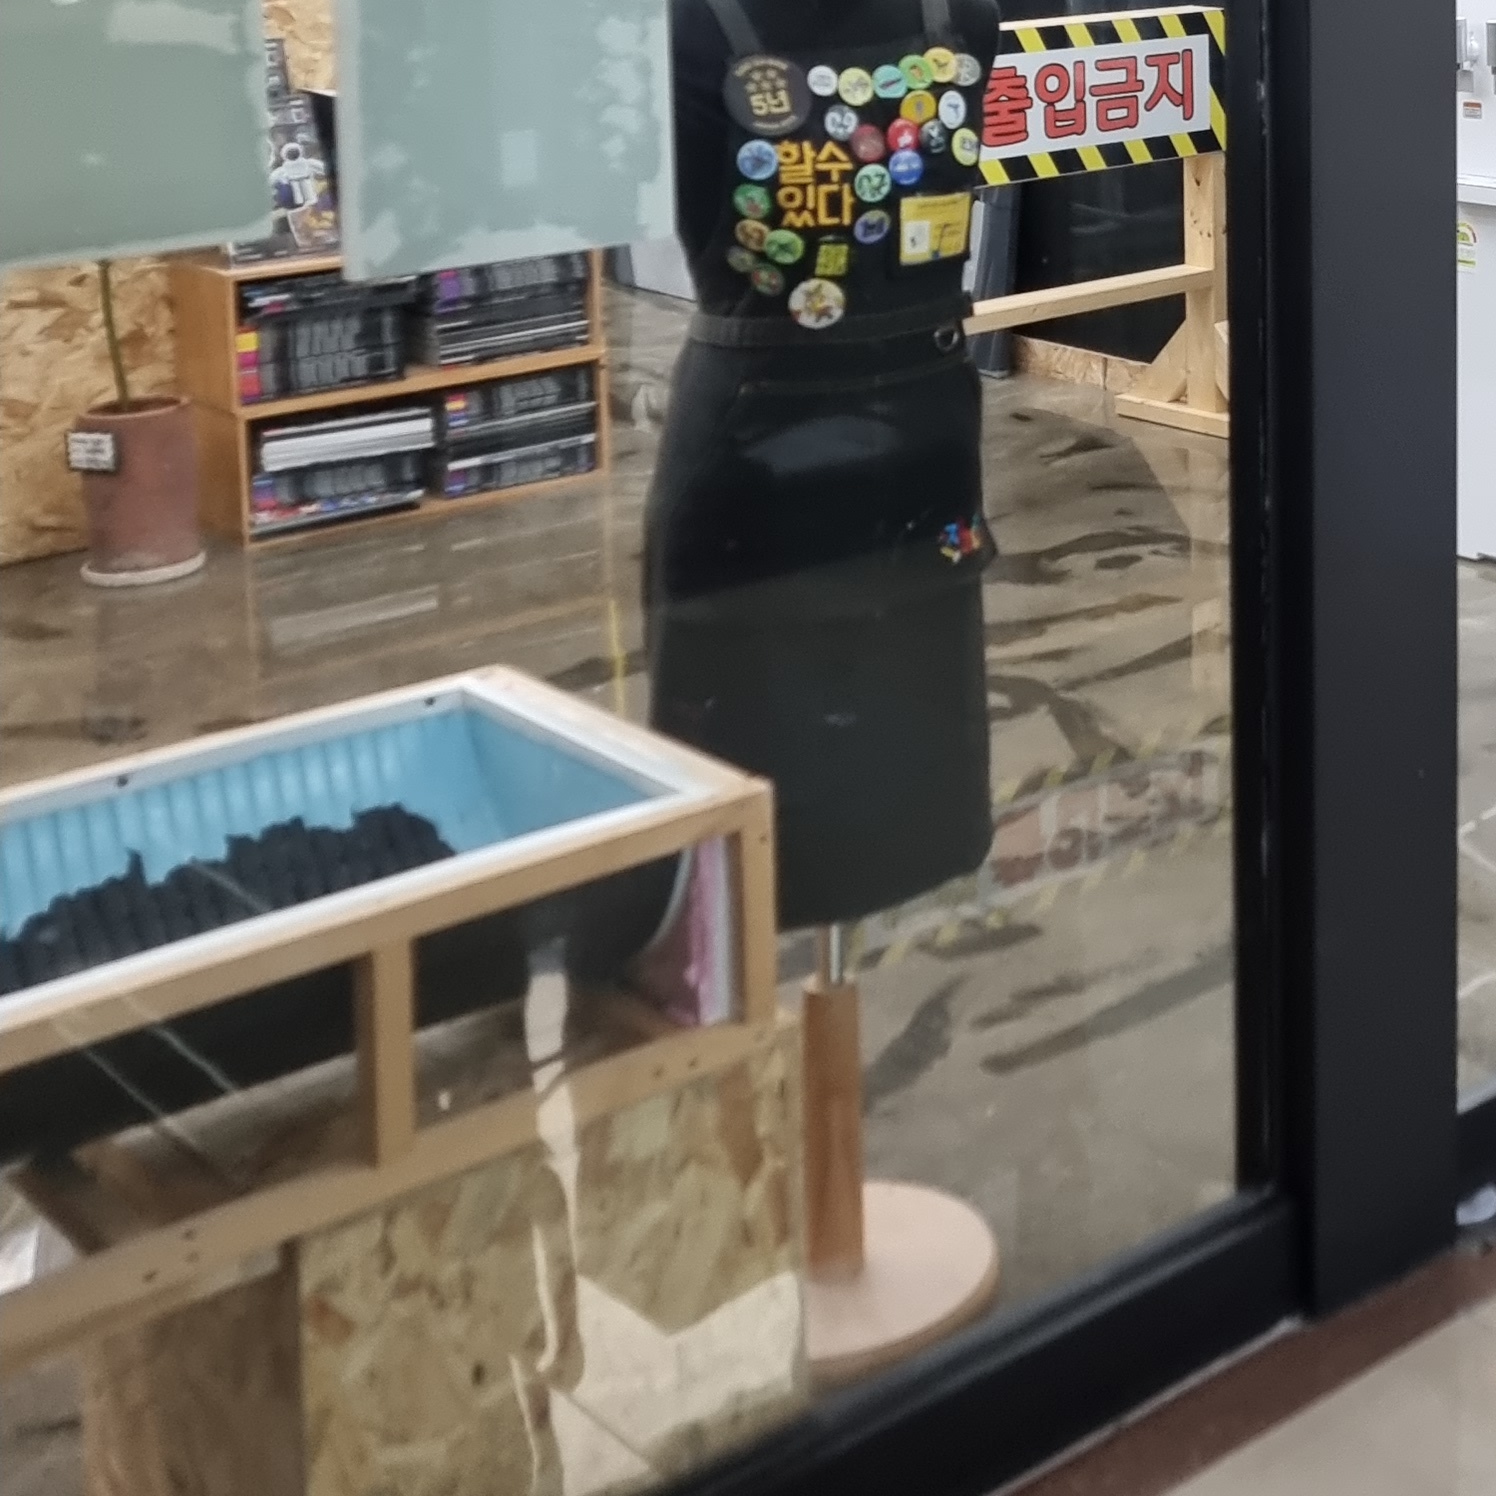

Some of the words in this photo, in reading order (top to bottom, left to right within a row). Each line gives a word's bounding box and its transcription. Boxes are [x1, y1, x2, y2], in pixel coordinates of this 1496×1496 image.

[750, 89, 792, 116] 5년
[981, 48, 1194, 148] 출입금지
[774, 139, 854, 185] 할수
[776, 183, 857, 228] 있다
